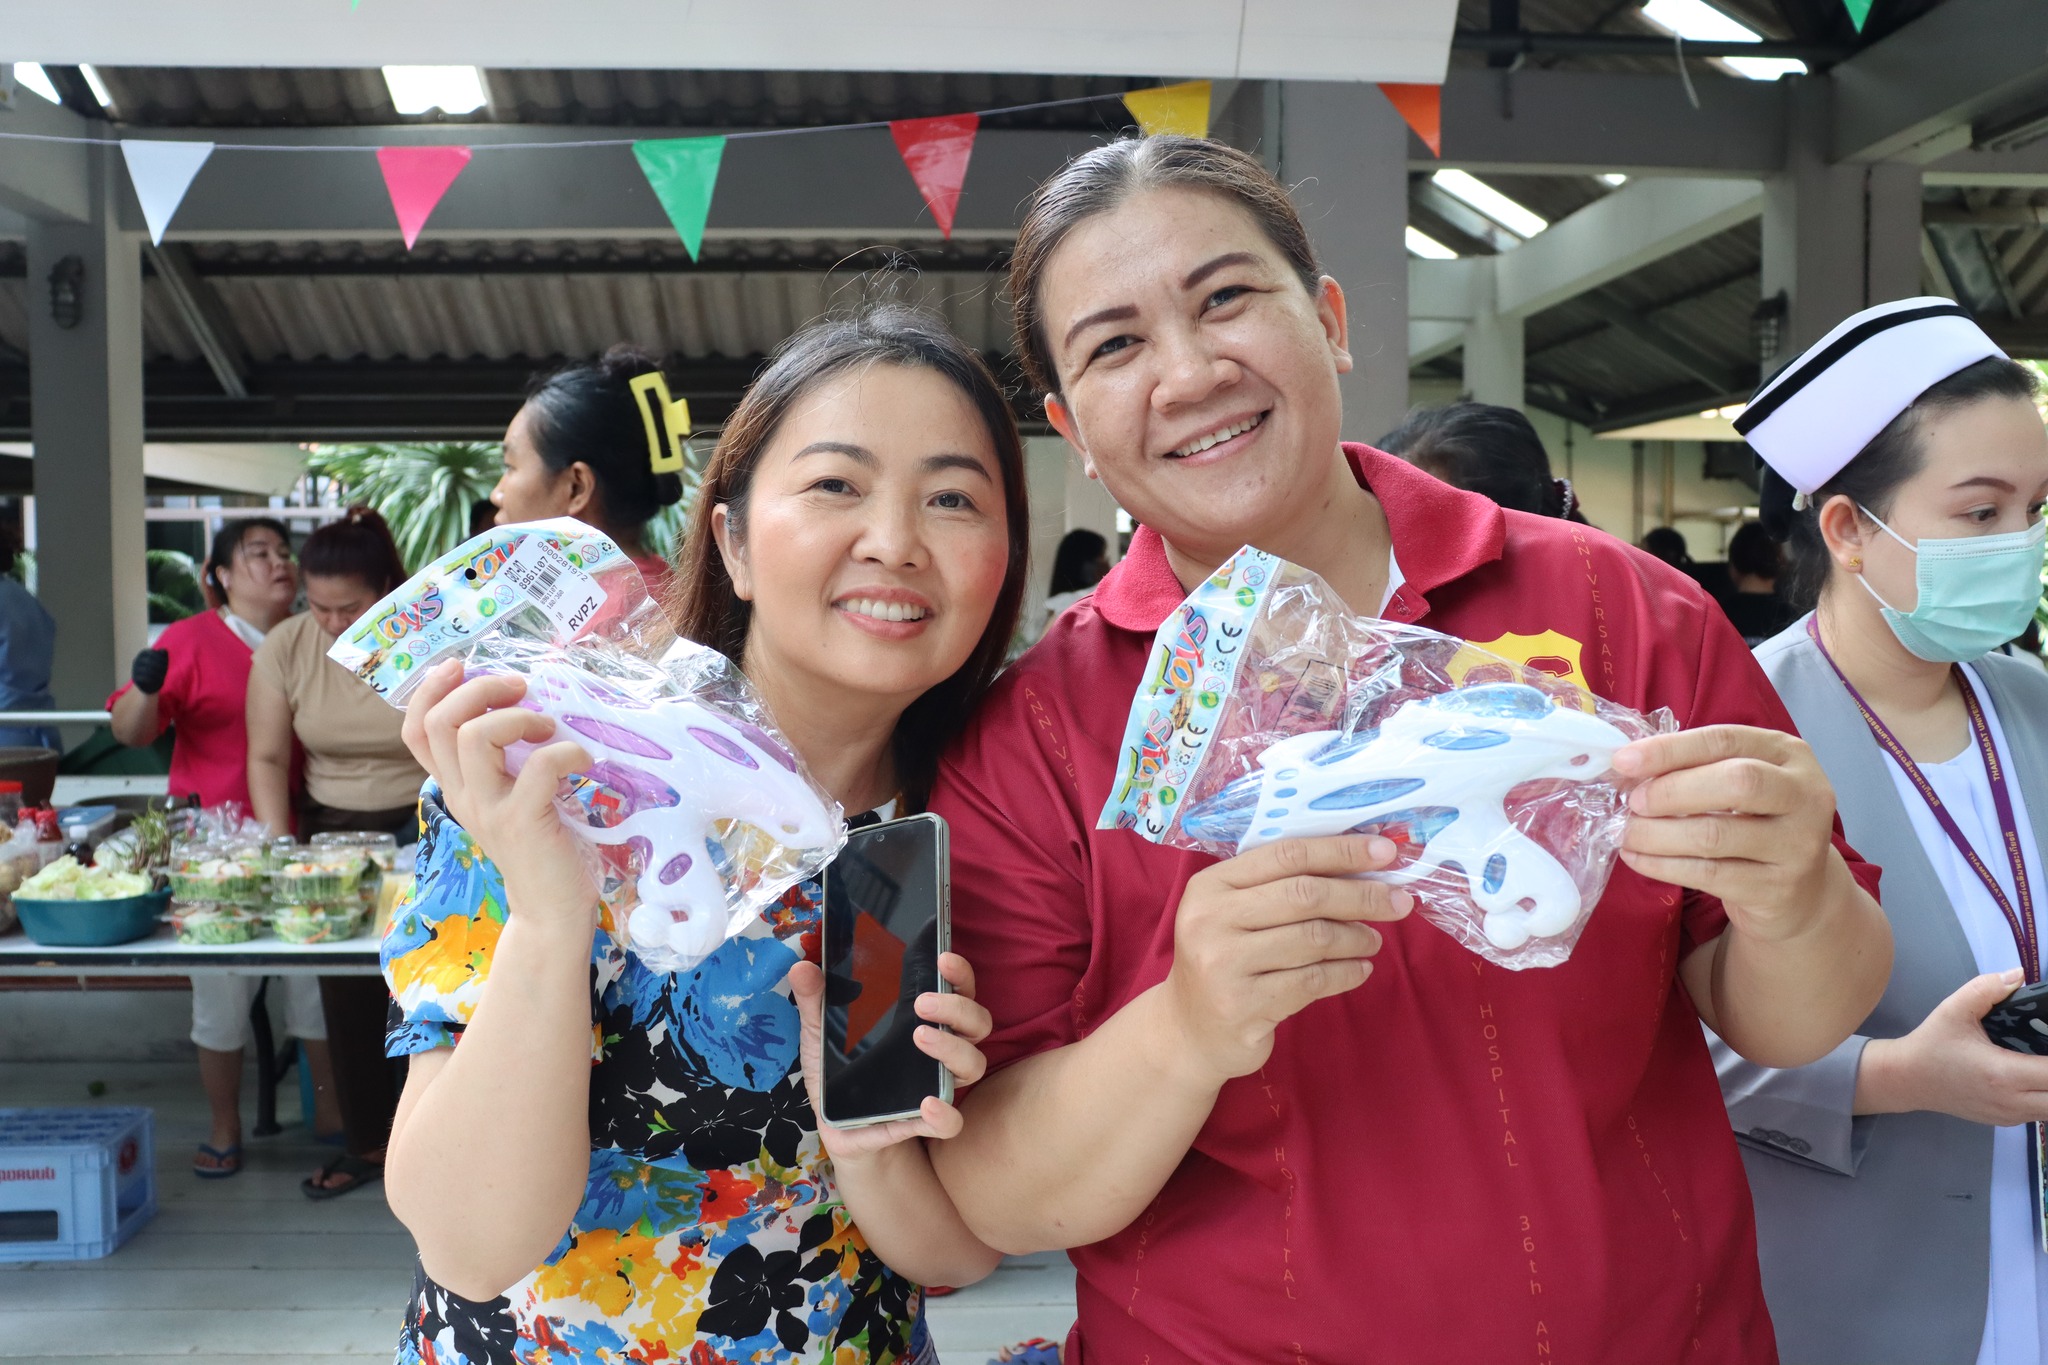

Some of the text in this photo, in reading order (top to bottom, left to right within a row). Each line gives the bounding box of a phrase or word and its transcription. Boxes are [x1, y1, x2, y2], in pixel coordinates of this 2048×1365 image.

[519, 556, 549, 590] 8961107
[537, 541, 589, 582] 0000281972
[568, 596, 598, 631] RVPZ
[1570, 526, 1615, 693] ANNIVERSARY
[1980, 732, 2001, 782] THAMMASAT
[1968, 851, 2001, 898] THAMMASAT
[2001, 898, 2025, 946] UNIVERSITY
[1479, 1003, 1519, 1167] HOSPITAL
[1519, 1215, 1542, 1295] 36th
[1627, 1115, 1688, 1241] OSPITAL
[1127, 1196, 1162, 1319] OSPITA
[1274, 1147, 1297, 1300] HOSPITAL
